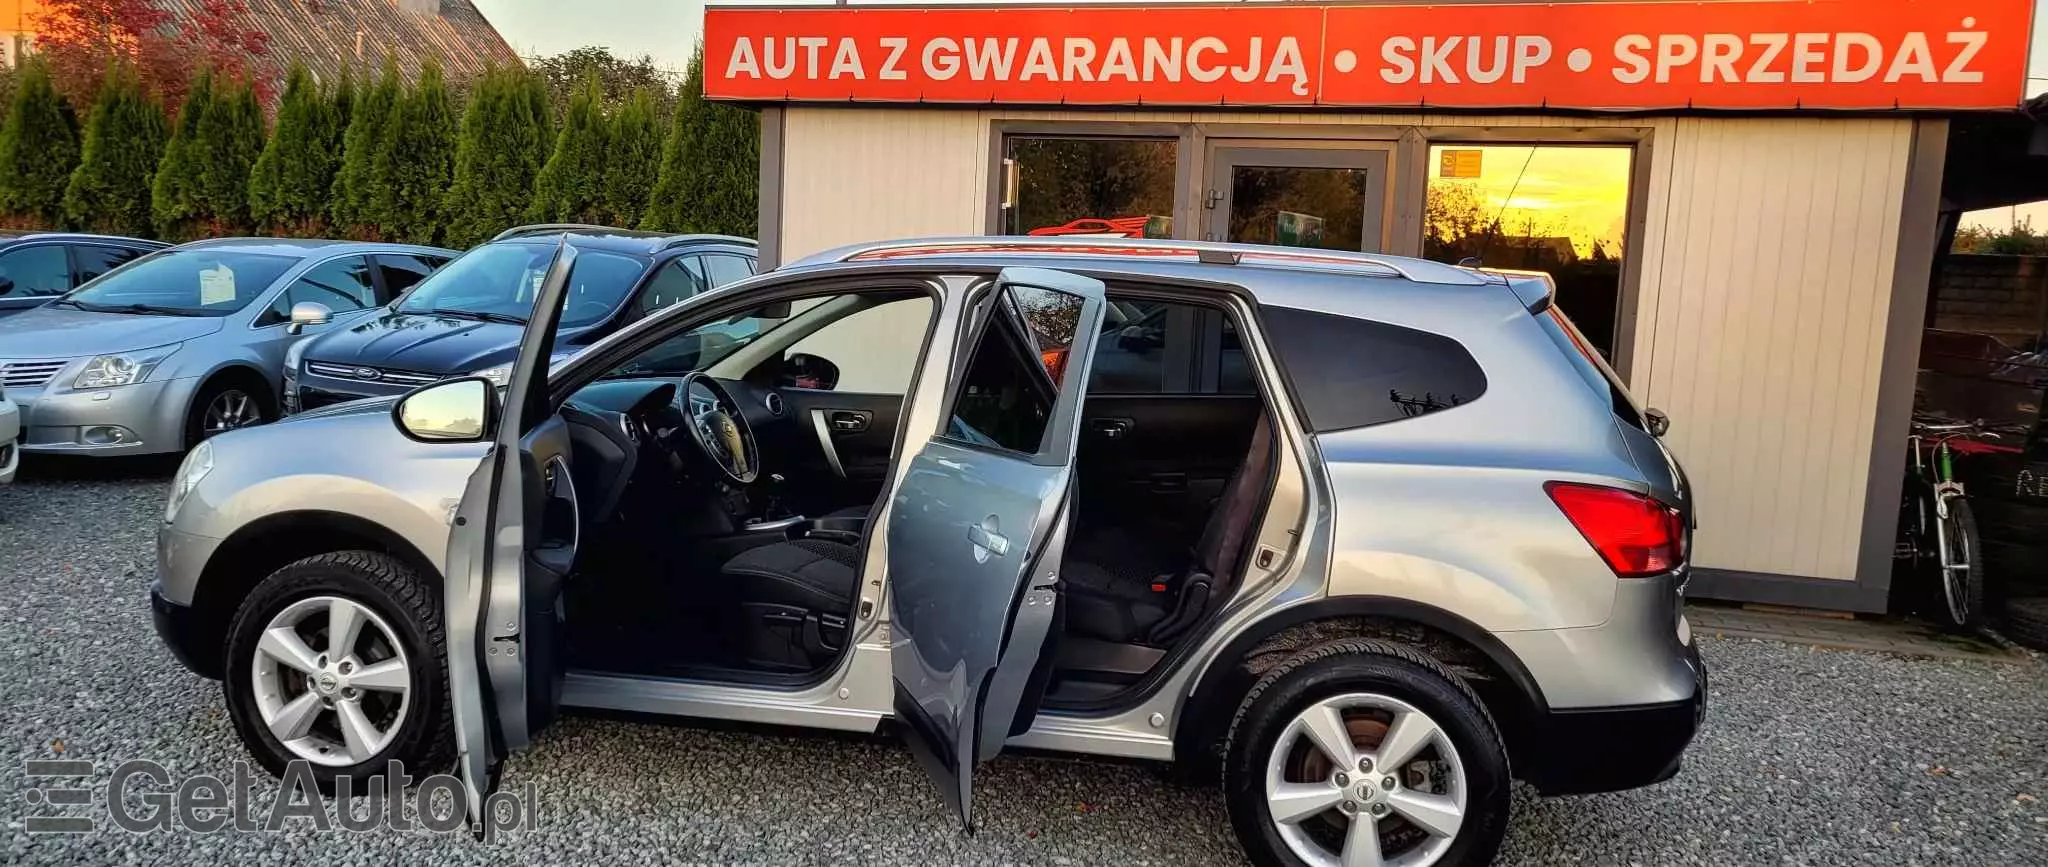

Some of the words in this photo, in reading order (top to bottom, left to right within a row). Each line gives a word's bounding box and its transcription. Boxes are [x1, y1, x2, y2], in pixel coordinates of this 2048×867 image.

[725, 36, 865, 80] AUTA
[879, 37, 908, 79] Z
[921, 37, 1308, 96] GWARANCJĄ
[1380, 35, 1552, 84] SKUP
[1611, 17, 1988, 84] SPRZEDAŻ
